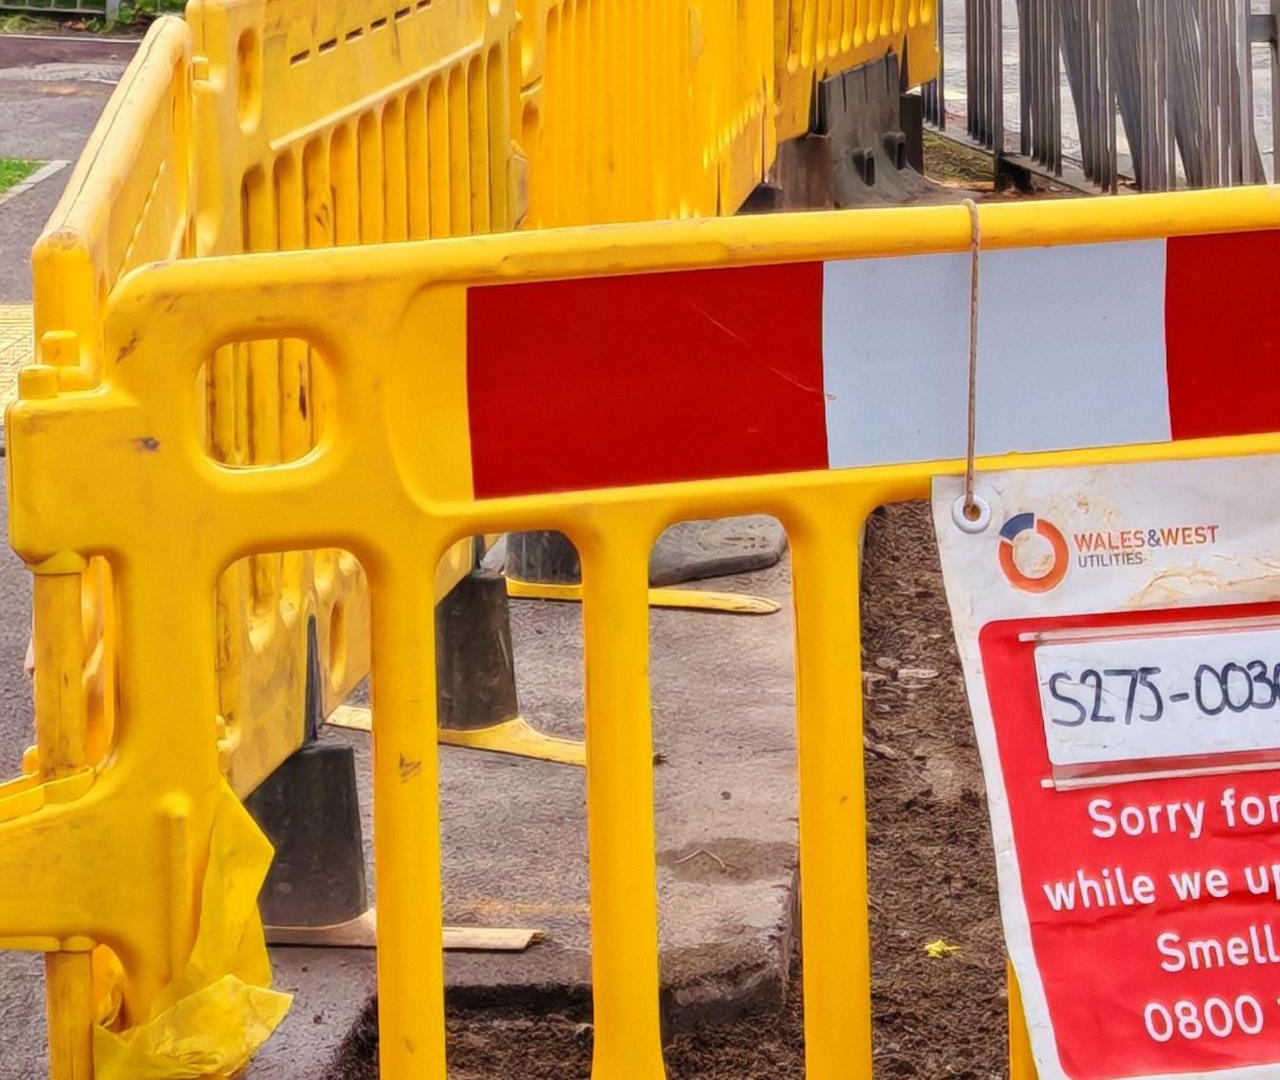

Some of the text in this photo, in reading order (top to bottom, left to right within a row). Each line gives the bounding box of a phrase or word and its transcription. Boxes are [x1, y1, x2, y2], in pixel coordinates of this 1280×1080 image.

[1073, 525, 1220, 553] WALES&WEST
[1077, 551, 1145, 569] UTILITIES
[1087, 798, 1205, 839] Sorry
[1042, 866, 1157, 912] while
[1169, 867, 1230, 901] we
[1142, 994, 1266, 1043] 0800
